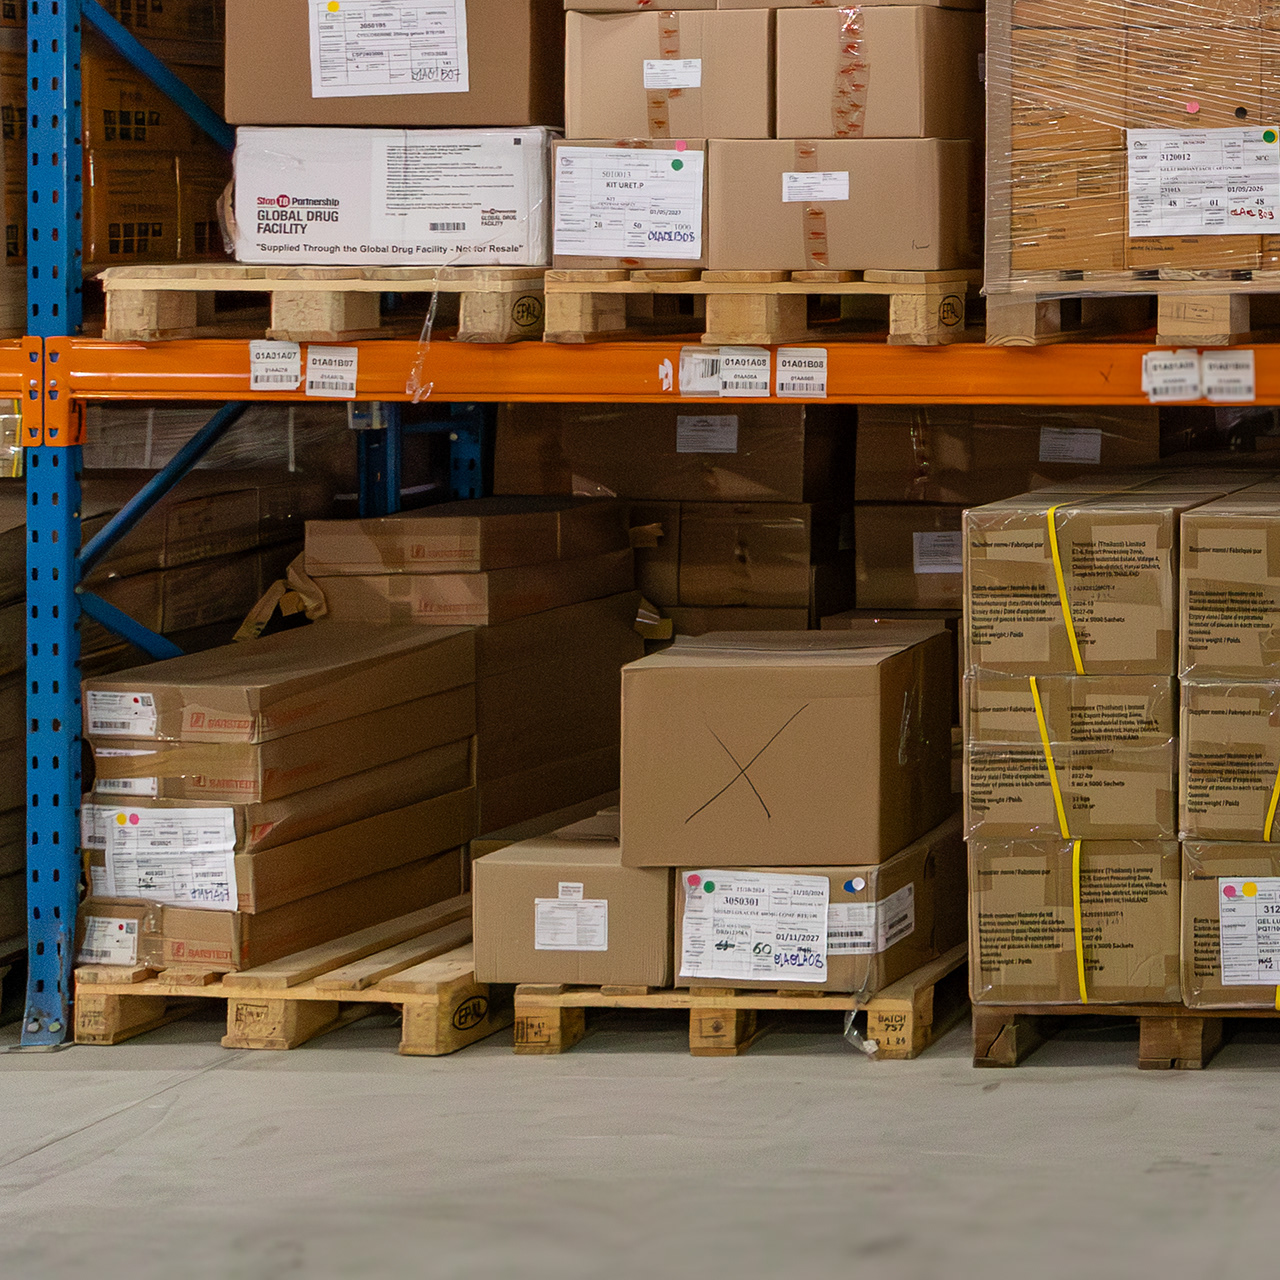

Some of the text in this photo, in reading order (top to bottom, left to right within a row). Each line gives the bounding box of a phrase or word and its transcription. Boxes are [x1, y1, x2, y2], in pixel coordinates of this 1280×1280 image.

[1160, 154, 1191, 162] 3120012
[602, 170, 631, 178] 5010013
[606, 181, 645, 190] KIT URET.P
[1227, 185, 1264, 194] 01/09/2026
[257, 196, 340, 208] Stop TB Partnership
[257, 210, 339, 223] GLOBAL DRUG
[649, 208, 682, 216] 01/05/2027
[257, 223, 308, 235] FACILITY
[674, 222, 691, 231] 1000
[303, 243, 341, 255] Through
[343, 244, 357, 253] the
[359, 244, 390, 253] Global
[392, 244, 414, 256] Drug
[416, 244, 448, 256] Facility
[725, 358, 767, 367] 01A01A08
[781, 360, 824, 368] 01A01B08
[724, 896, 760, 906] 3050301
[1257, 917, 1271, 926] GEL
[776, 933, 820, 943] 01/11/2027
[753, 942, 773, 955] 60
